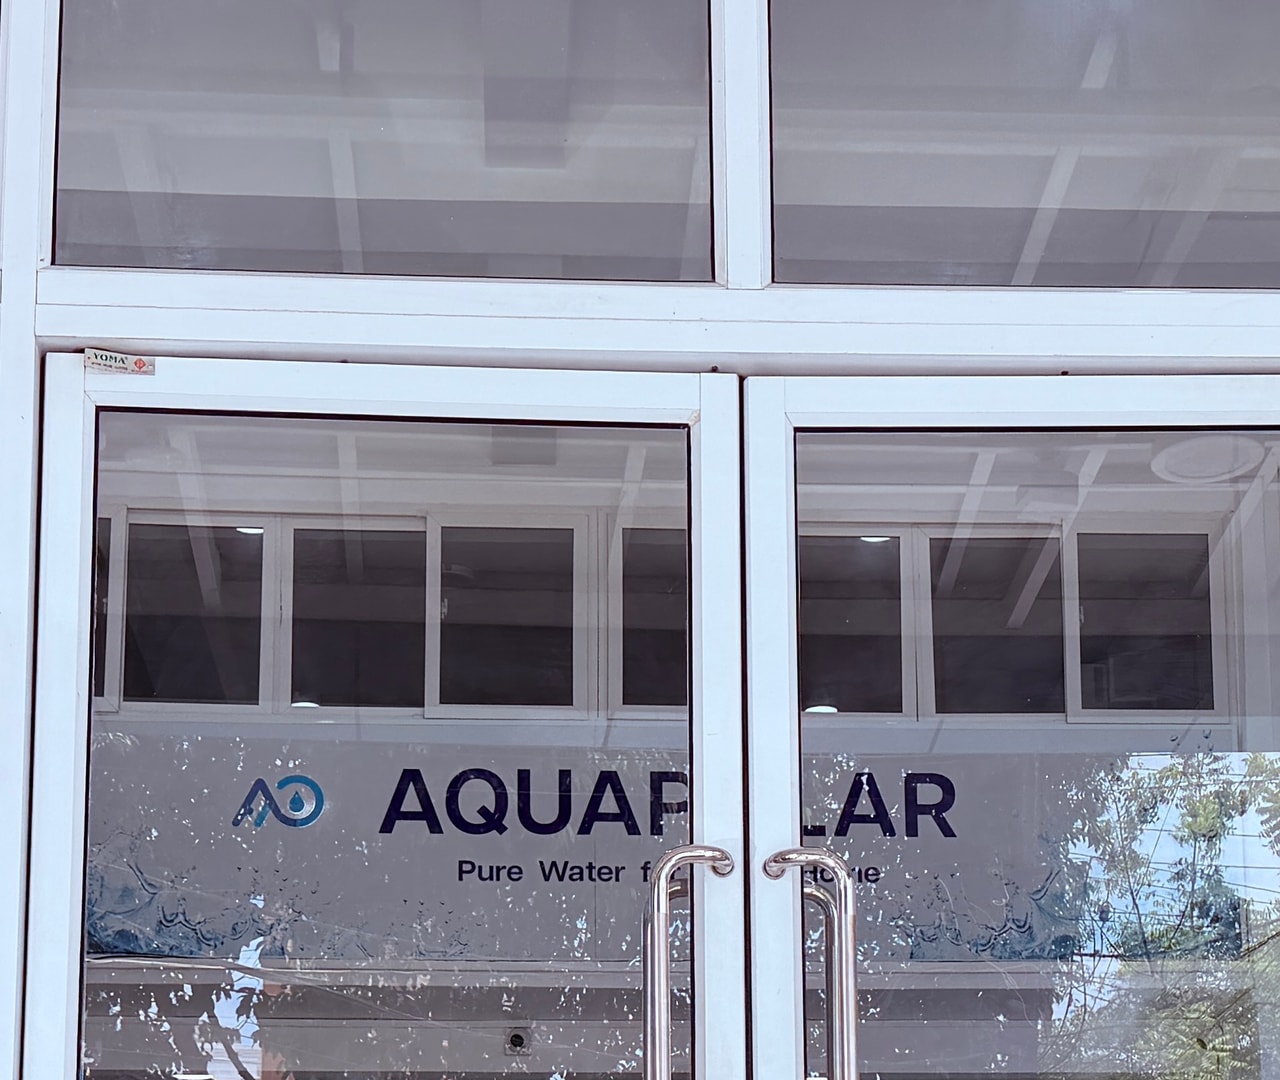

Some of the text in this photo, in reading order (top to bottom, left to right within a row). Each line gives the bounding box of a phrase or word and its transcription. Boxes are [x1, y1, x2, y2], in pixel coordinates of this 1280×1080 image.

[94, 352, 127, 364] YOMA
[378, 768, 957, 838] AQUAPAR
[458, 860, 524, 882] Pure
[538, 860, 626, 882] Water
